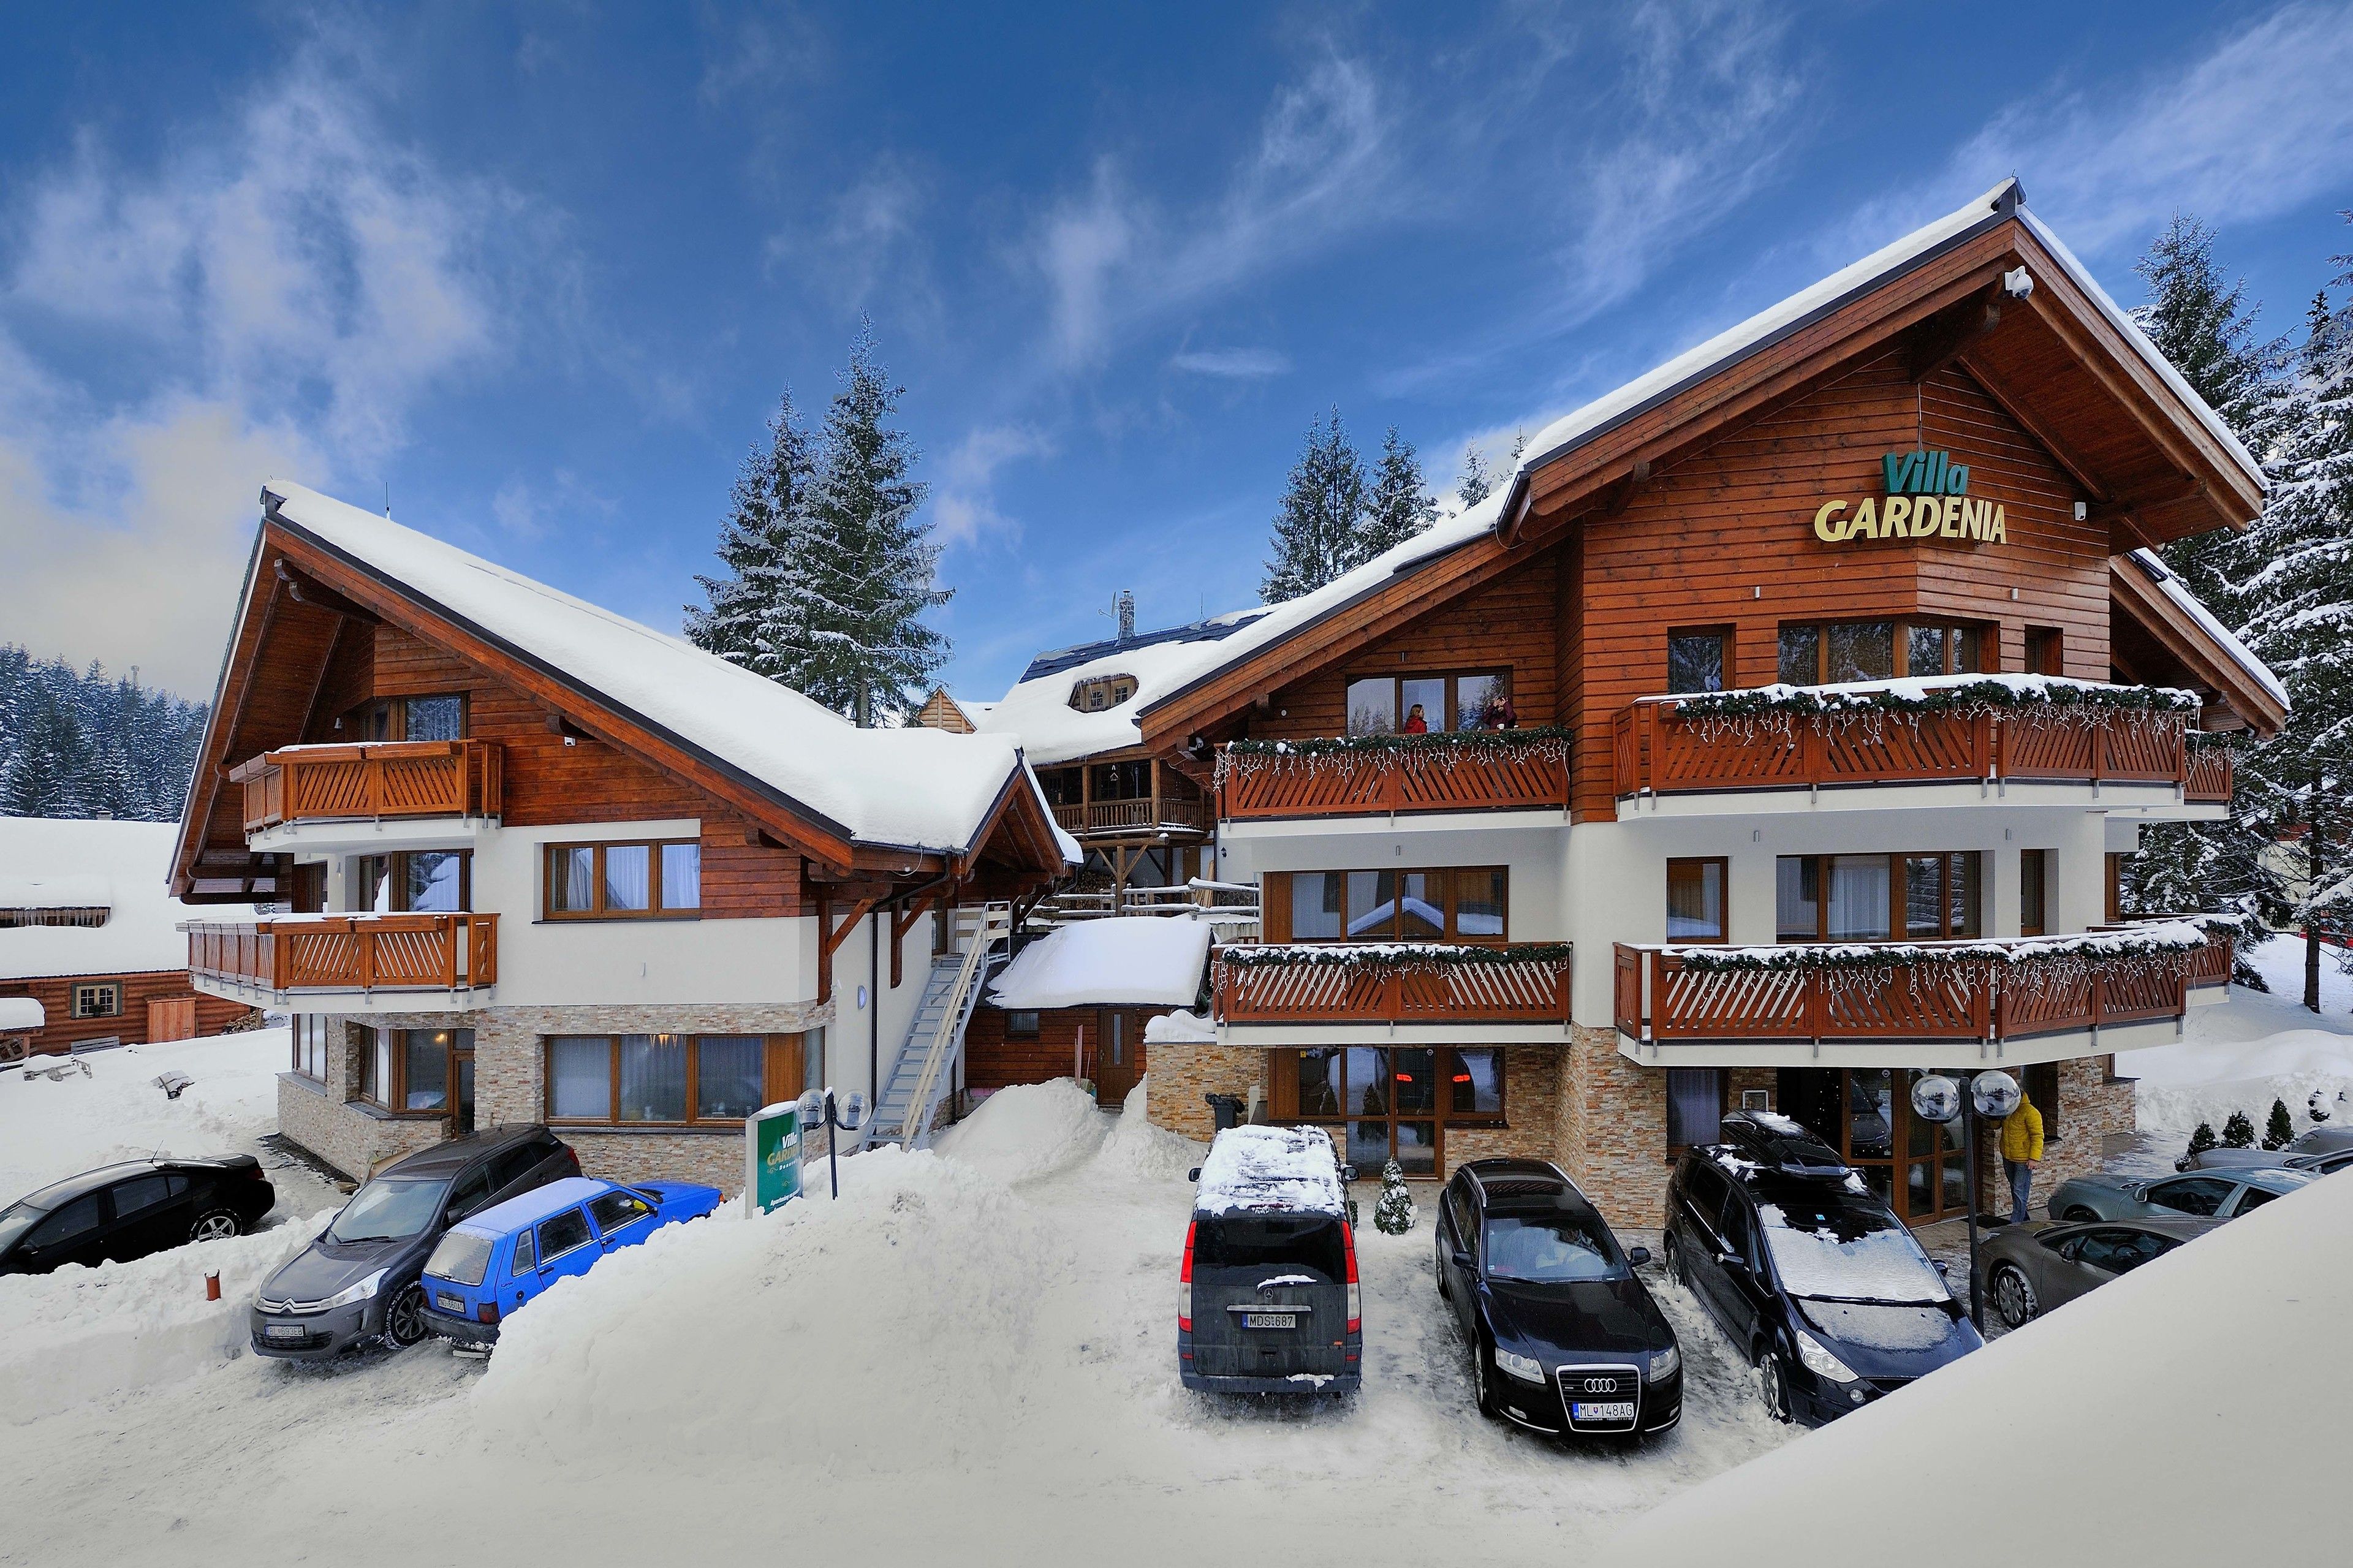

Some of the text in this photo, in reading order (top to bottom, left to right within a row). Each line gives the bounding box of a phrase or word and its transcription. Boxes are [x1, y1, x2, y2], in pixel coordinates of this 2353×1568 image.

[1882, 449, 1970, 495] Villa
[1814, 496, 2007, 544] GARDENIA
[782, 1132, 797, 1149] Villa
